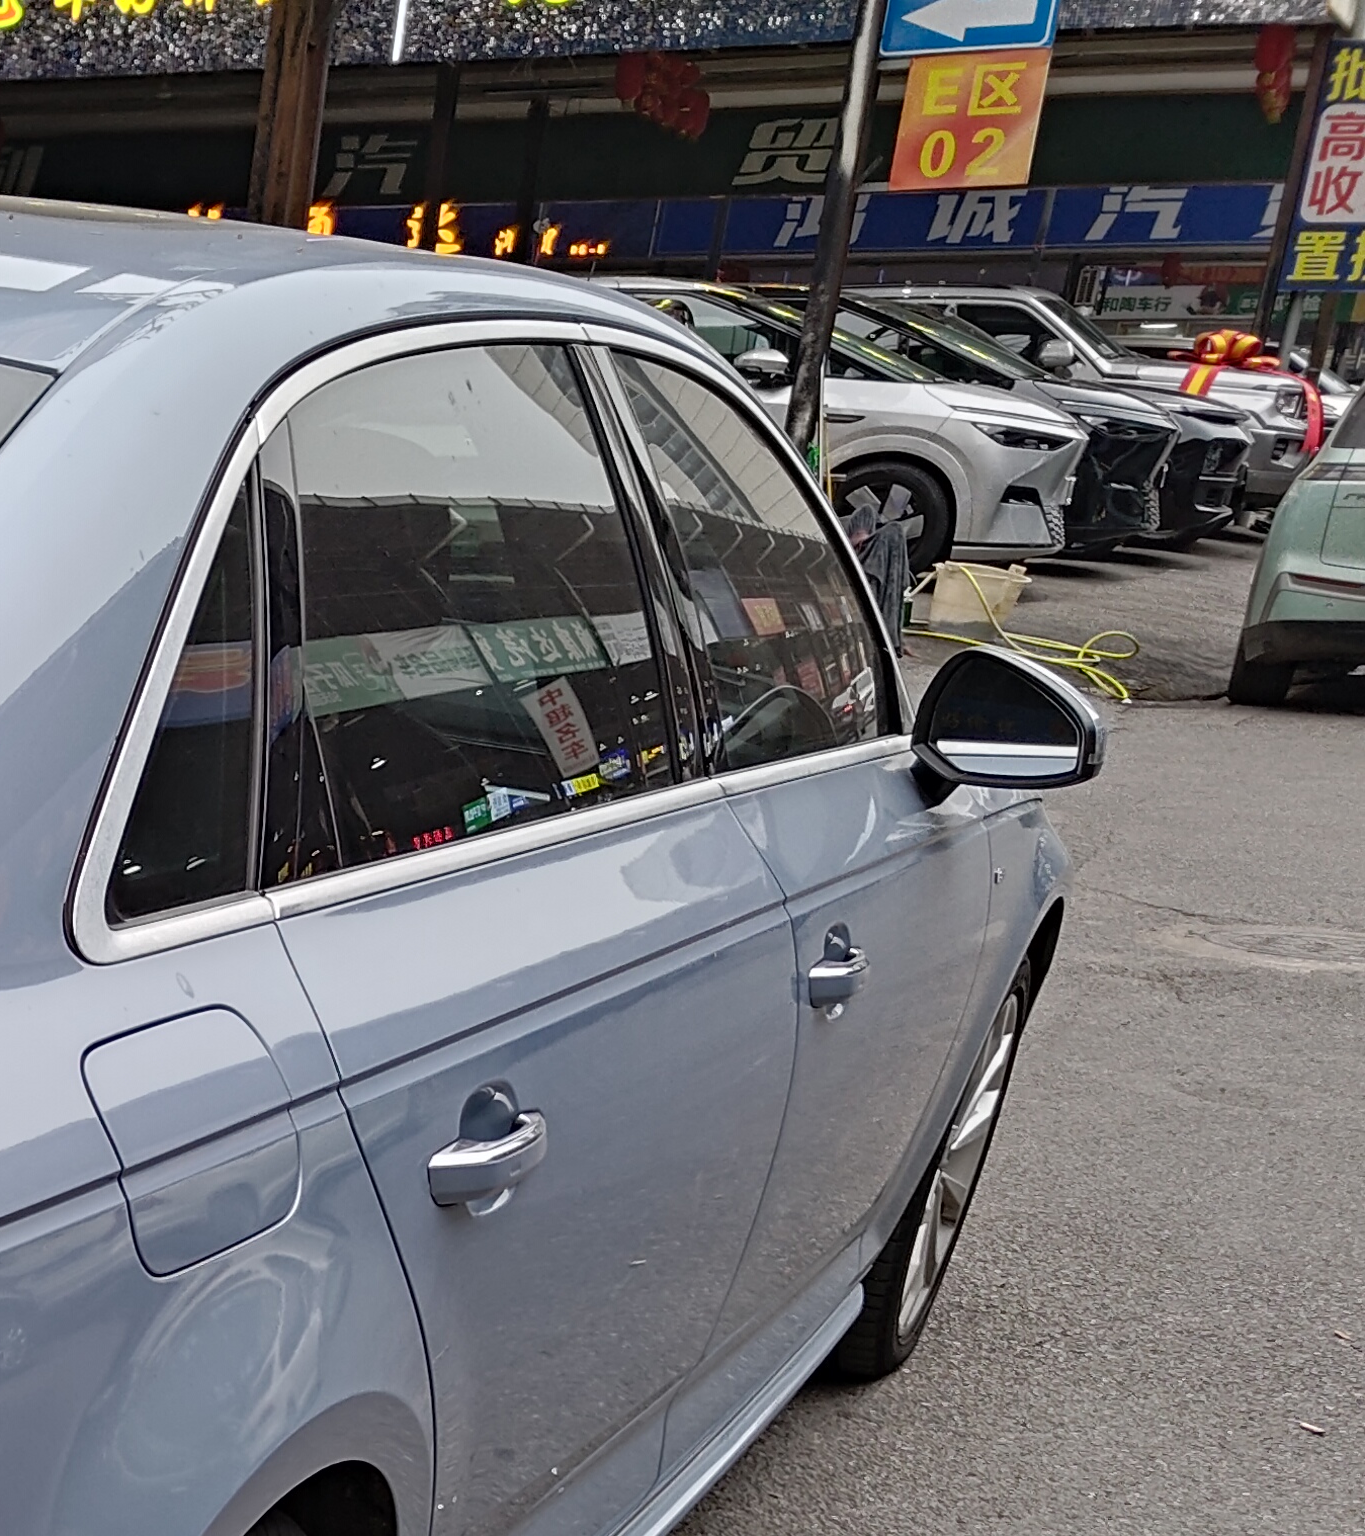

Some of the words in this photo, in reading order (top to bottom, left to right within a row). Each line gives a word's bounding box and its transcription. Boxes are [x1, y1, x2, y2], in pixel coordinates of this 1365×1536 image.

[921, 61, 1028, 117] E区
[919, 128, 1006, 179] 02
[1307, 166, 1361, 216] 收
